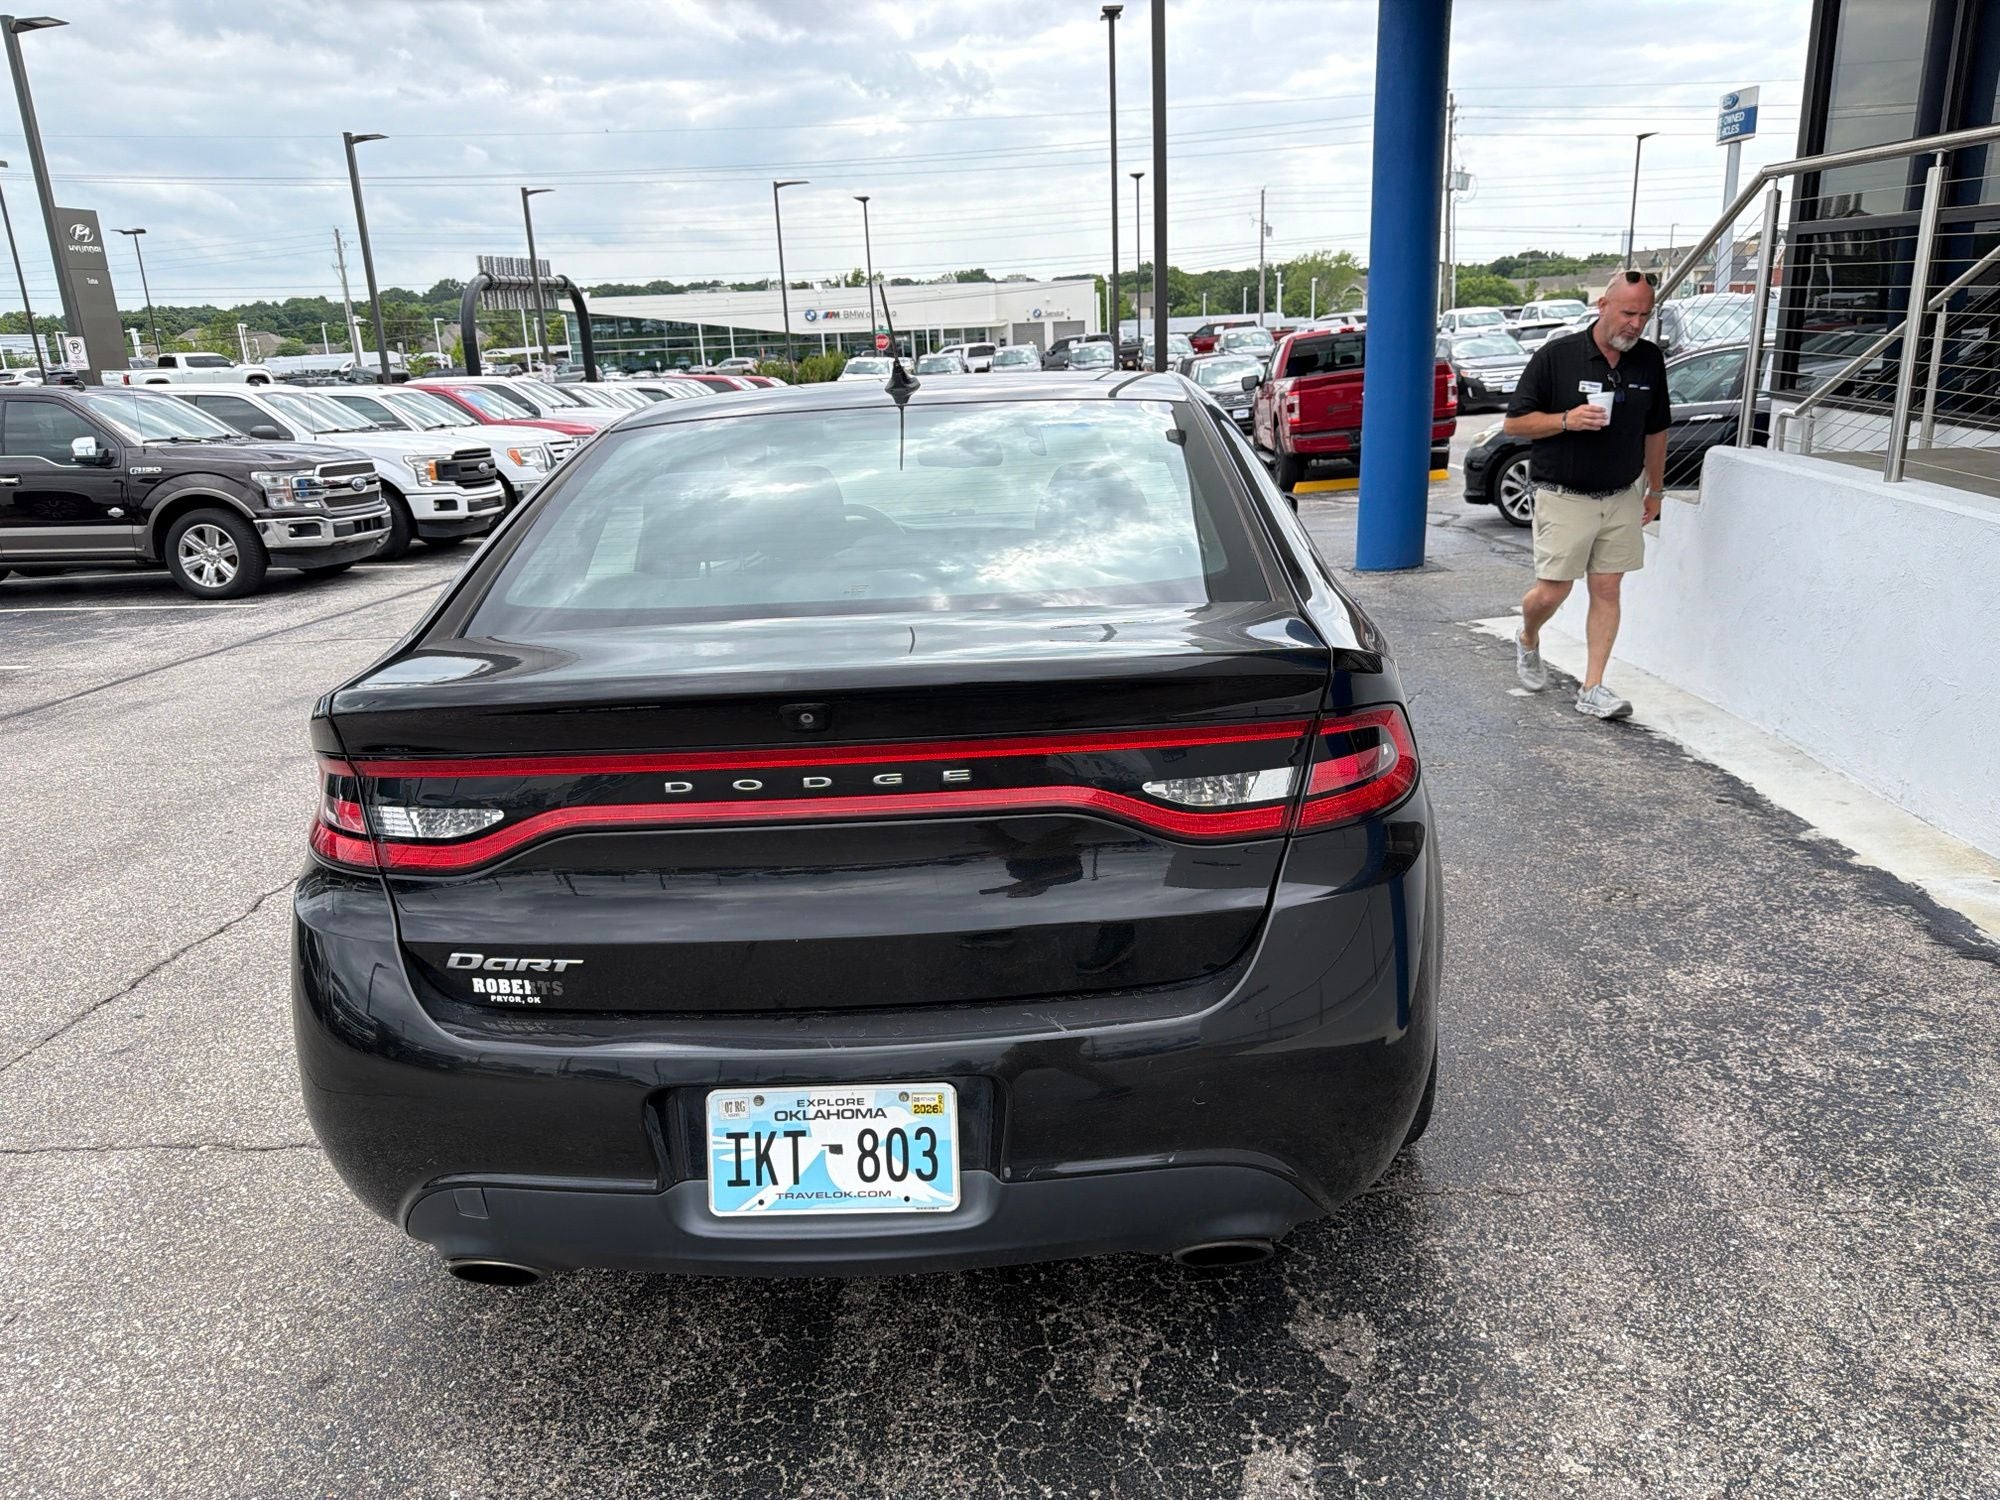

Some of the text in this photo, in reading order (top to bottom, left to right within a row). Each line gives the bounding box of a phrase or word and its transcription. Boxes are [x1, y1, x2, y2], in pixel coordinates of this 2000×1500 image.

[843, 311, 864, 319] BMW
[665, 769, 970, 793] DODGE
[472, 977, 564, 996] ROBERTS
[490, 995, 541, 1004] PRYOR, OK
[796, 1097, 865, 1108] EXPLORE
[774, 1107, 888, 1122] OKLAHOMA
[913, 1104, 939, 1114] 2026
[726, 1127, 938, 1187] IKT 803
[776, 1190, 892, 1200] TRAVELOK.COM
